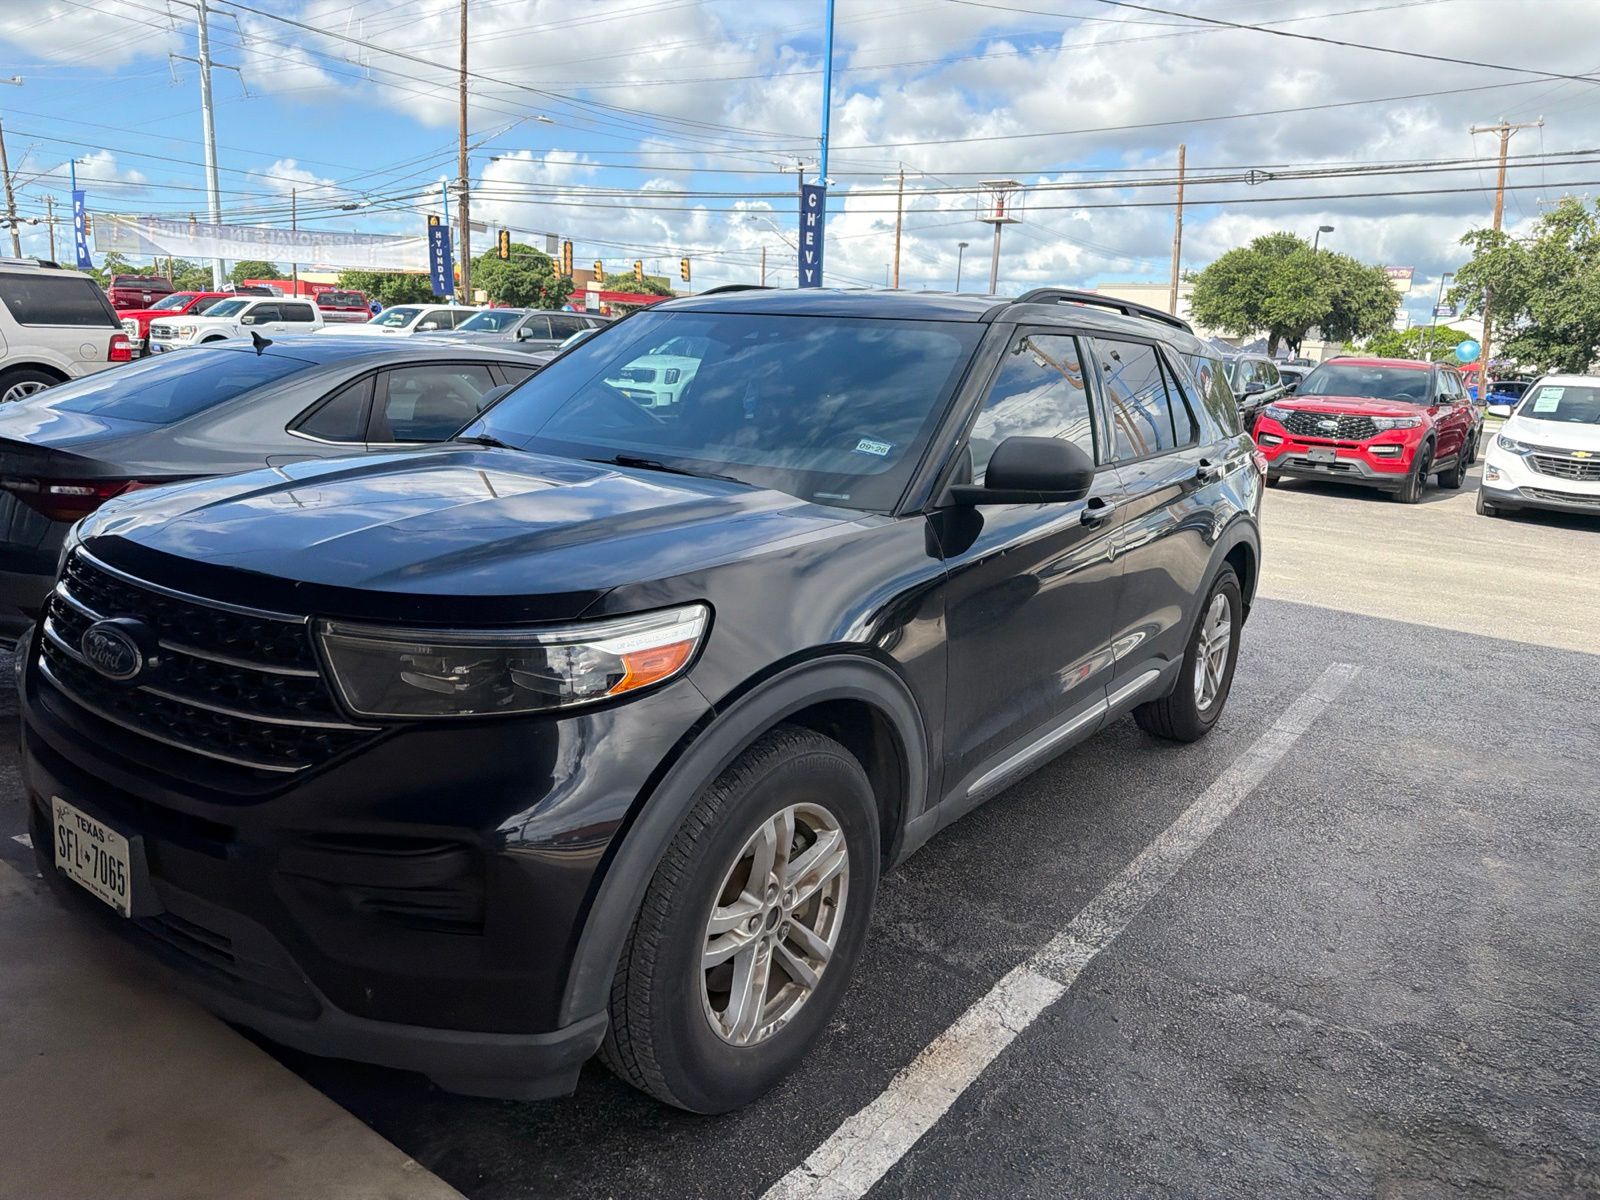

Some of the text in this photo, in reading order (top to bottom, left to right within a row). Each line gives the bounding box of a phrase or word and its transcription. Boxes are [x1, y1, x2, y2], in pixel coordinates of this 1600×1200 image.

[75, 201, 85, 259] FORD
[805, 193, 817, 283] CHEVY
[435, 231, 445, 290] HYUNDAI
[89, 632, 125, 669] Ford
[75, 813, 105, 843] TEXAS
